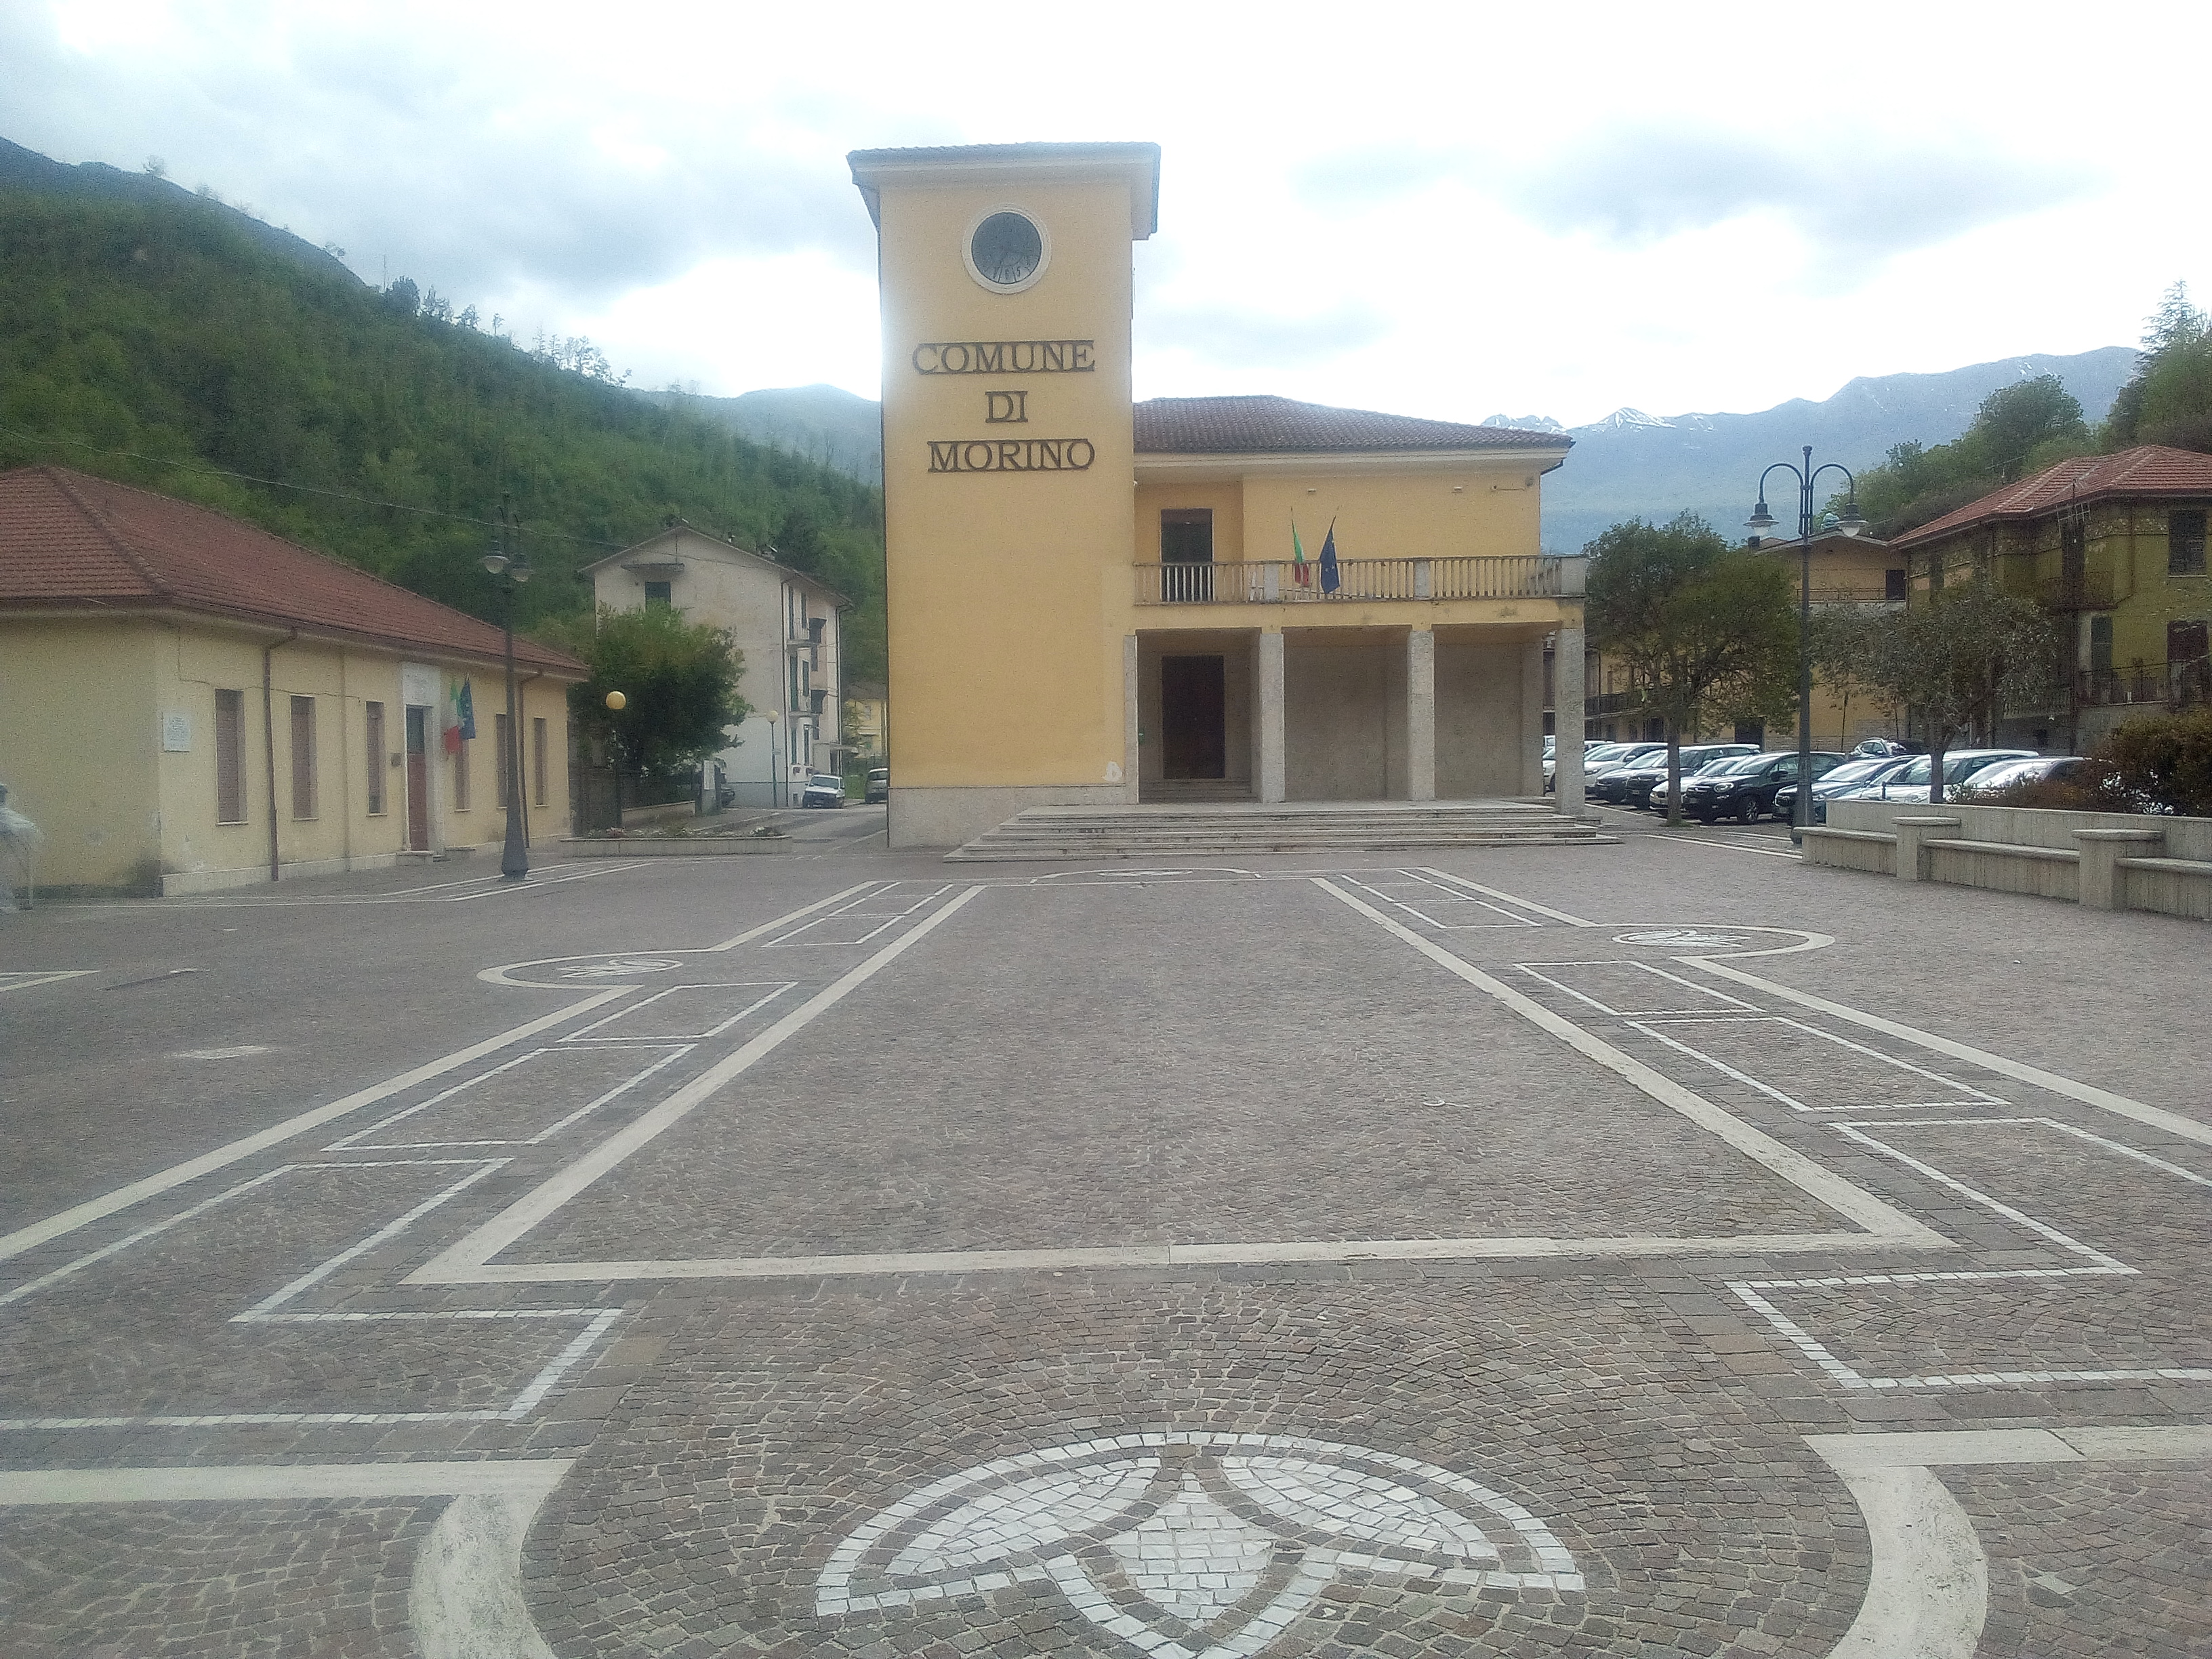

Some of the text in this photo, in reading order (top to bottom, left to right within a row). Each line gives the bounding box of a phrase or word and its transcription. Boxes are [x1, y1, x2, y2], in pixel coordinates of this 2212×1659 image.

[912, 340, 1095, 375] COMUNE
[985, 390, 1029, 424] DI
[926, 438, 1095, 473] MORINO
